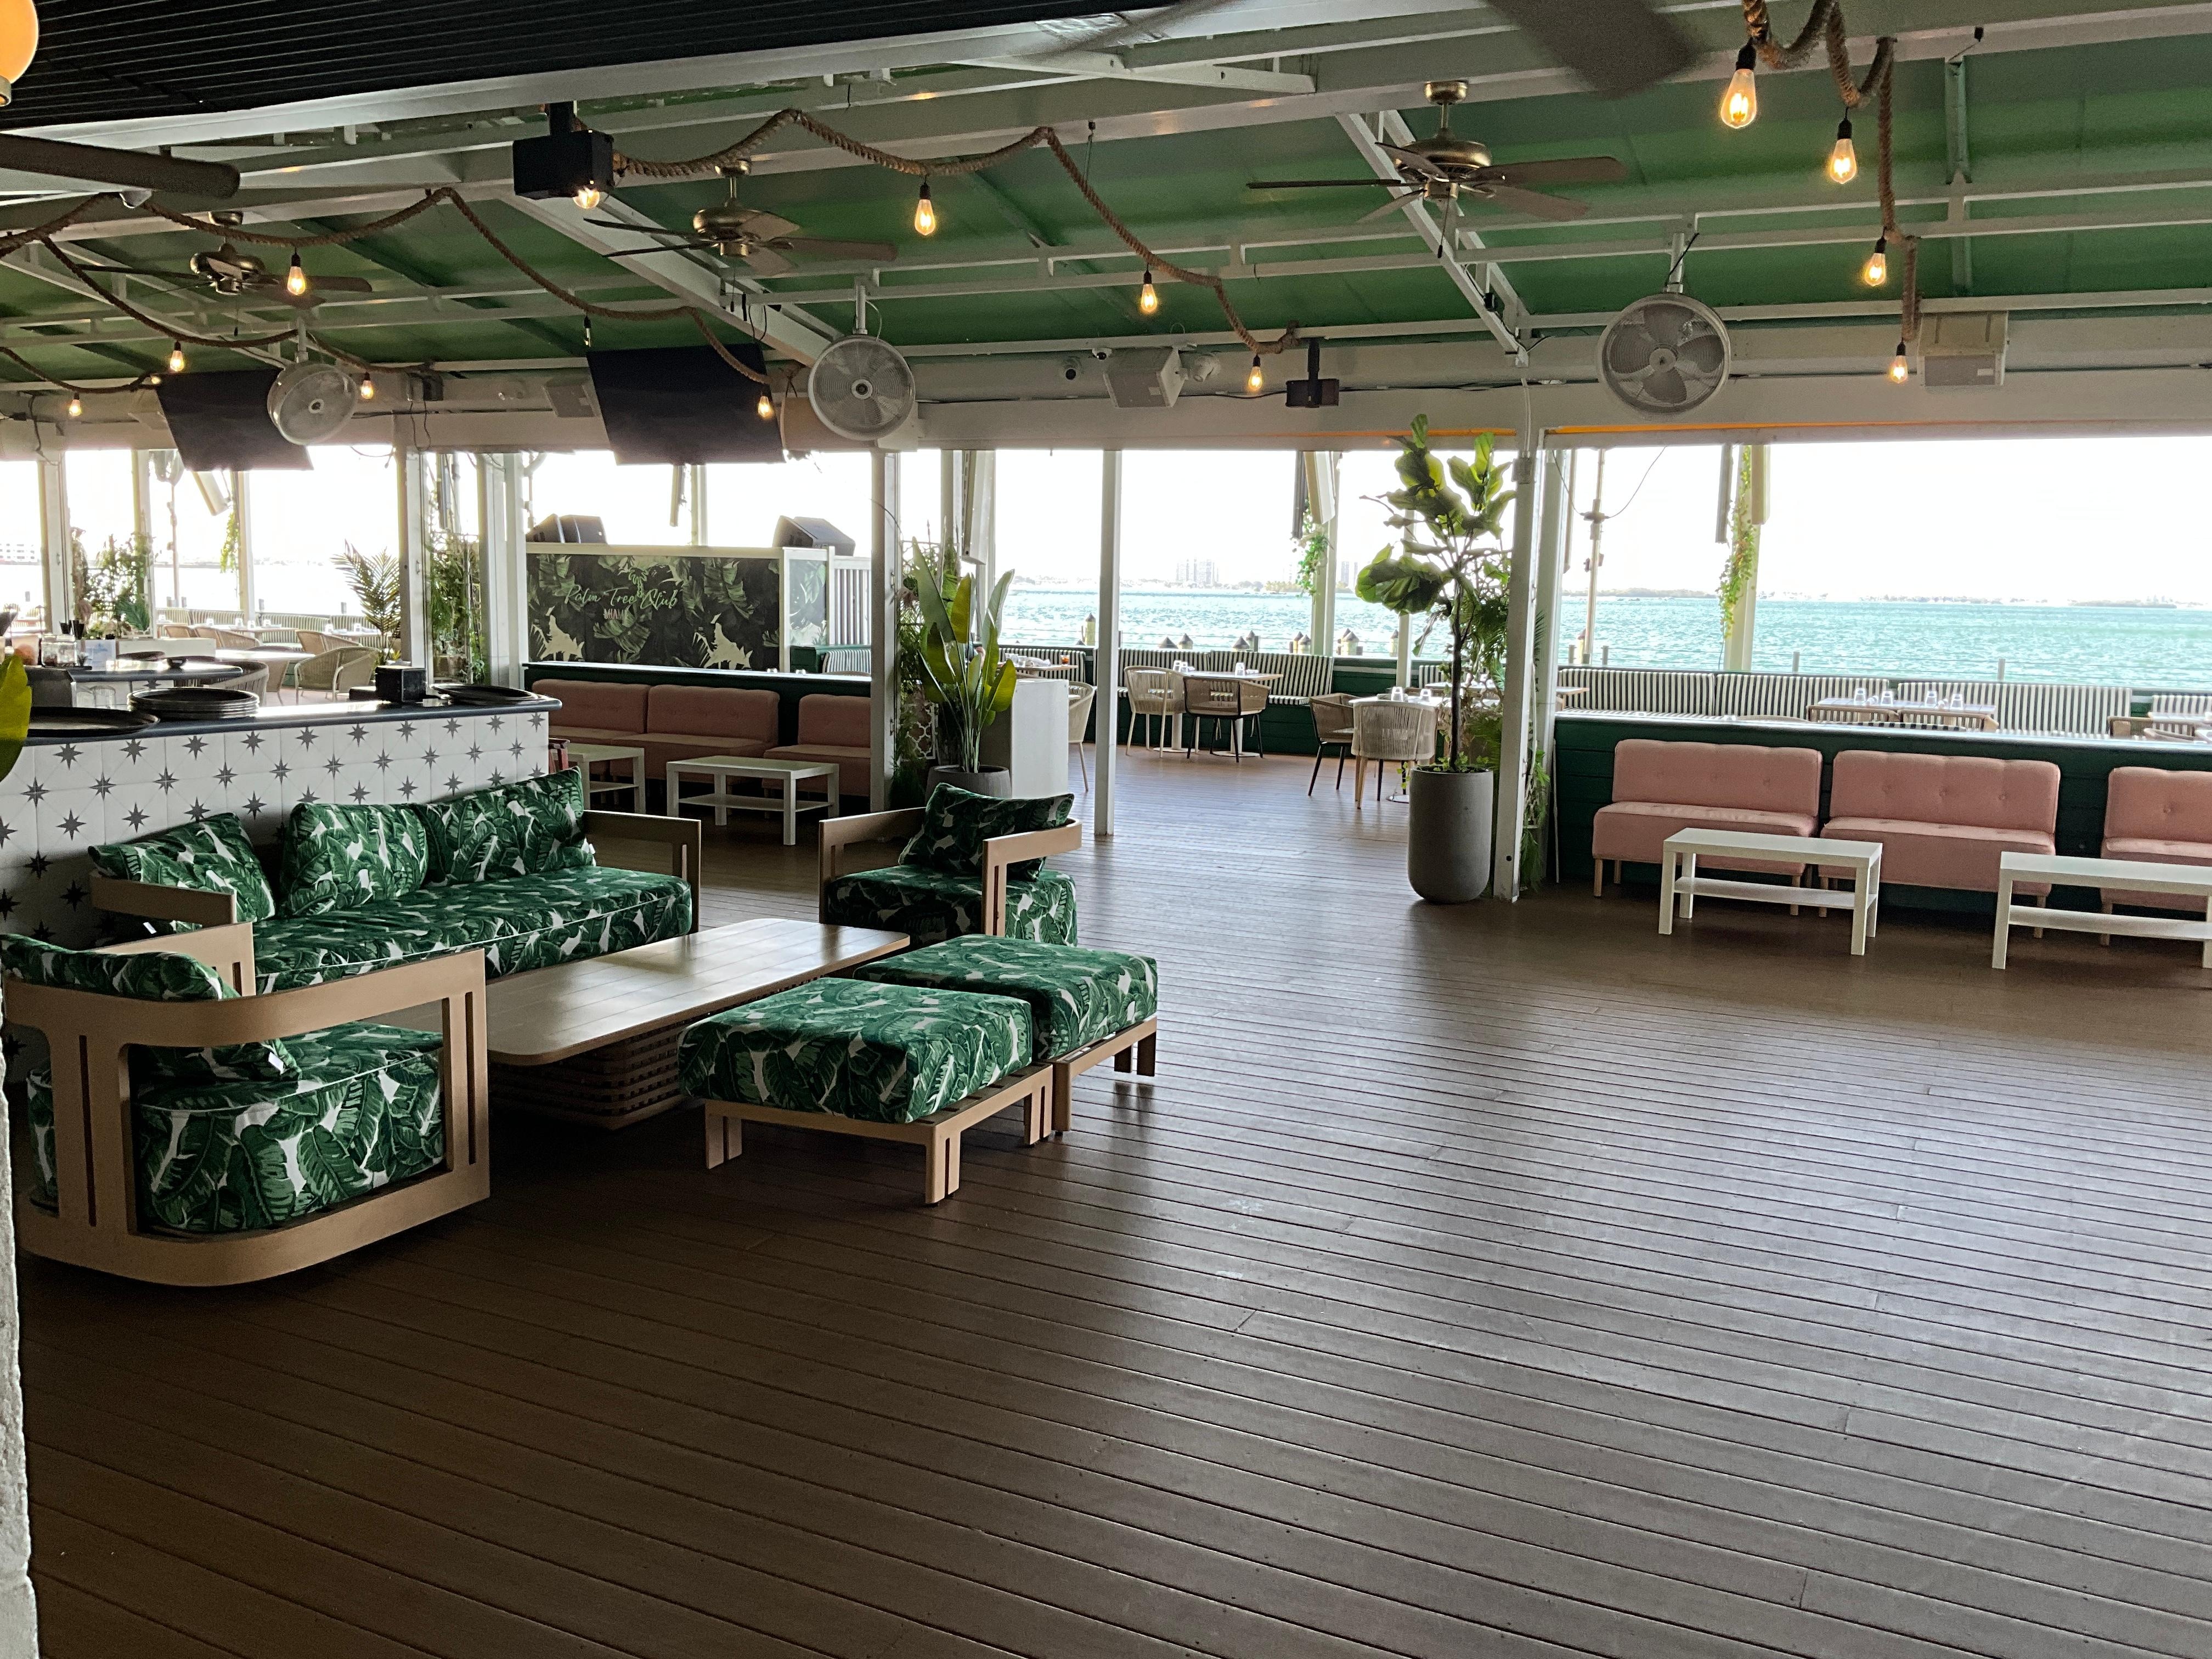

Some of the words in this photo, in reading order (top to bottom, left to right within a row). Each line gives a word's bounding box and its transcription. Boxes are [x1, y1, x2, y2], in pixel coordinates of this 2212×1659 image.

[564, 584, 601, 604] Palm
[604, 588, 637, 606] Tree
[640, 588, 678, 610] Club
